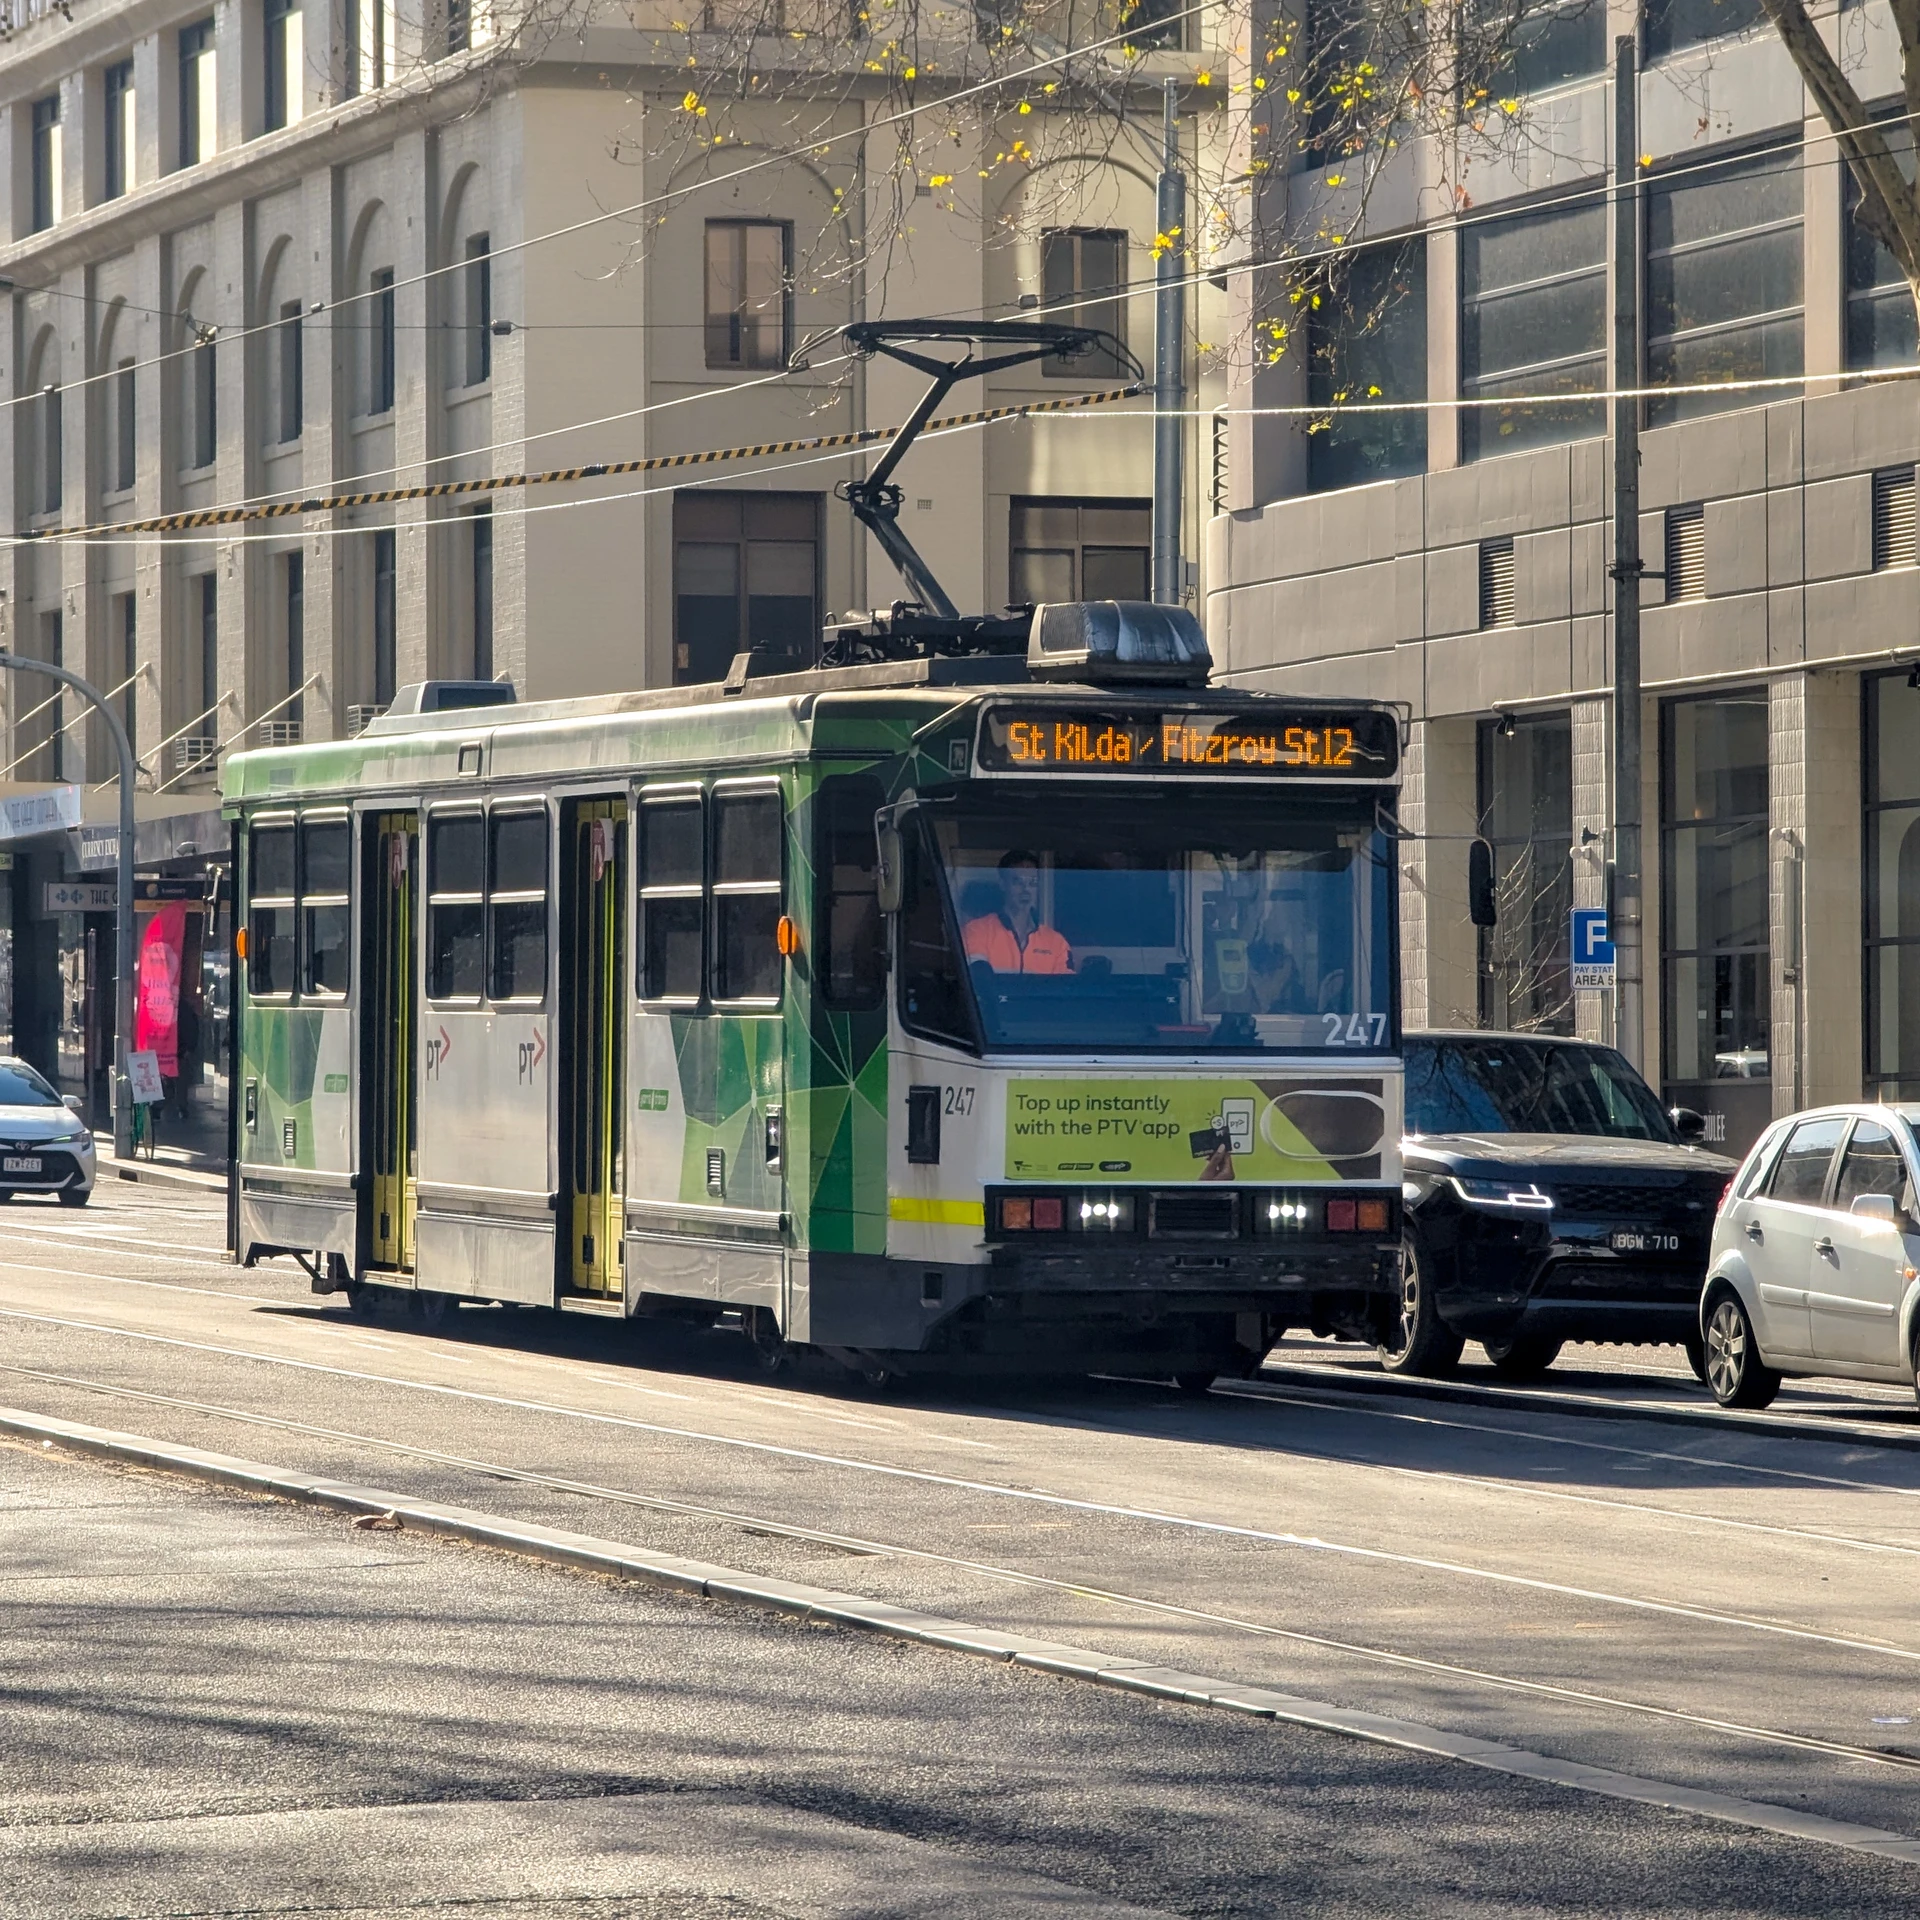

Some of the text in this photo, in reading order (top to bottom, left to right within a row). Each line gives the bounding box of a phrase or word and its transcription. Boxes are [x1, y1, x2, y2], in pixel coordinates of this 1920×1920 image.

[1010, 721, 1046, 760] St
[1055, 723, 1131, 762] Kilda
[1163, 725, 1276, 764] Fitzroy
[1574, 966, 1589, 974] PAY
[1574, 975, 1604, 986] AREA
[1322, 1012, 1386, 1045] 247
[945, 1086, 975, 1116] 247
[1015, 1094, 1170, 1115] Top up instantly
[1015, 1118, 1180, 1139] with the PTV app
